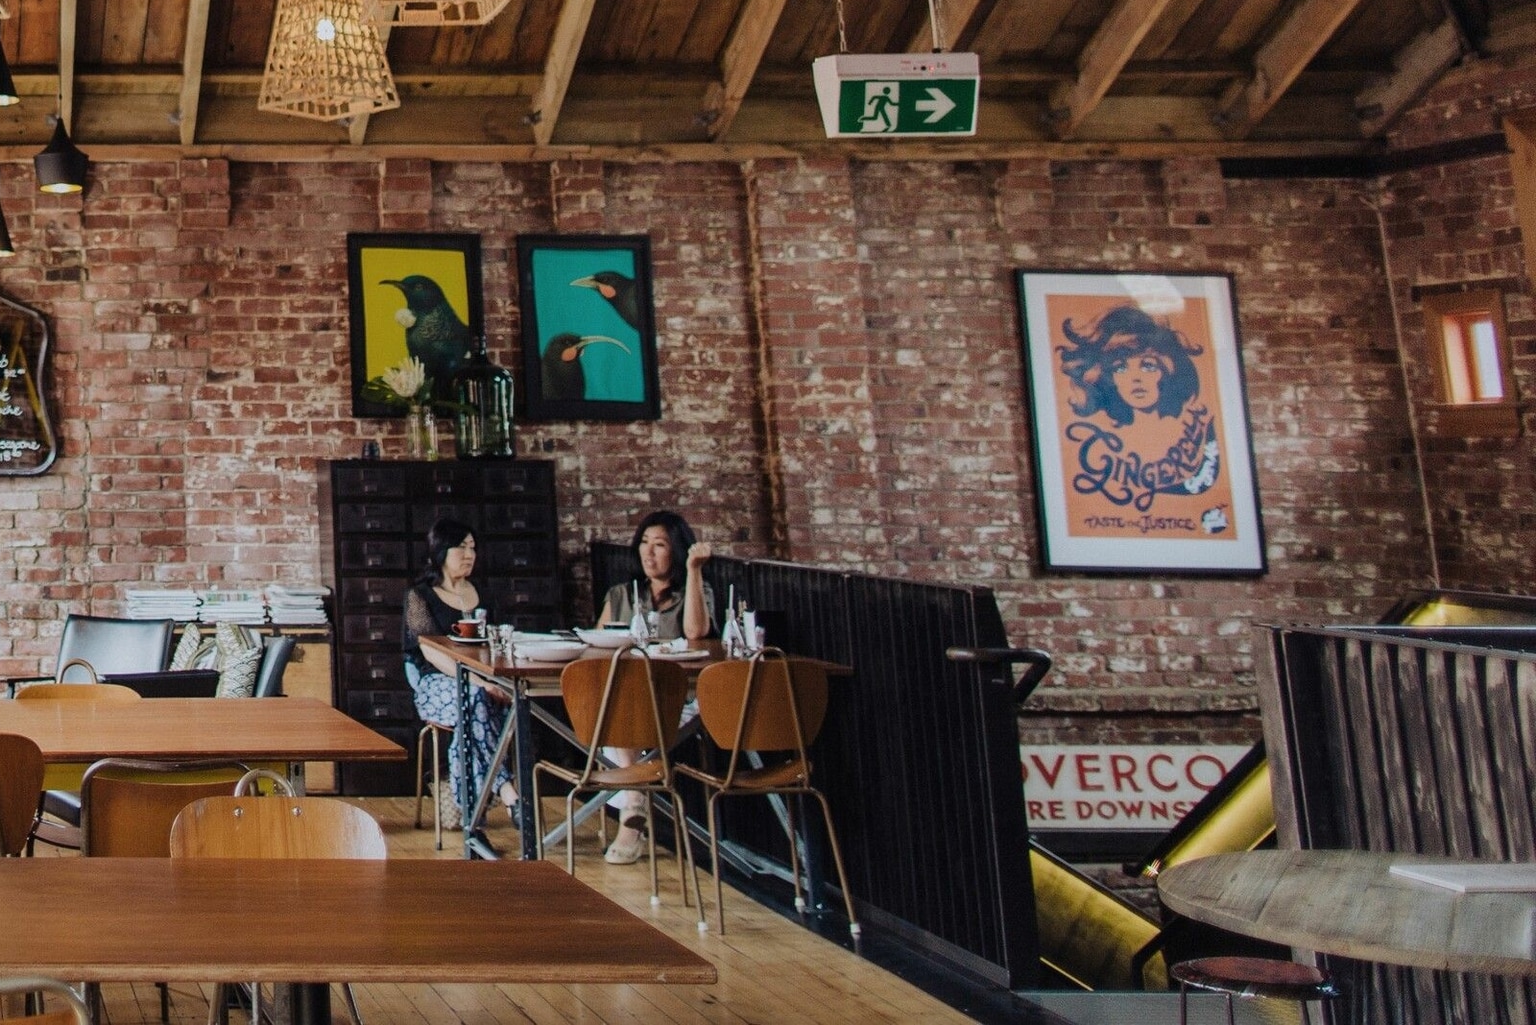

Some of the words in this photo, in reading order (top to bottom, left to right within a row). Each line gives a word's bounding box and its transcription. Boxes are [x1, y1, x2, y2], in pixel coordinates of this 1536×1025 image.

[1084, 516, 1125, 529] TASTE
[1141, 515, 1197, 533] JUSTICE
[1020, 754, 1227, 792] VERCO
[1075, 801, 1198, 820] DOWNS
